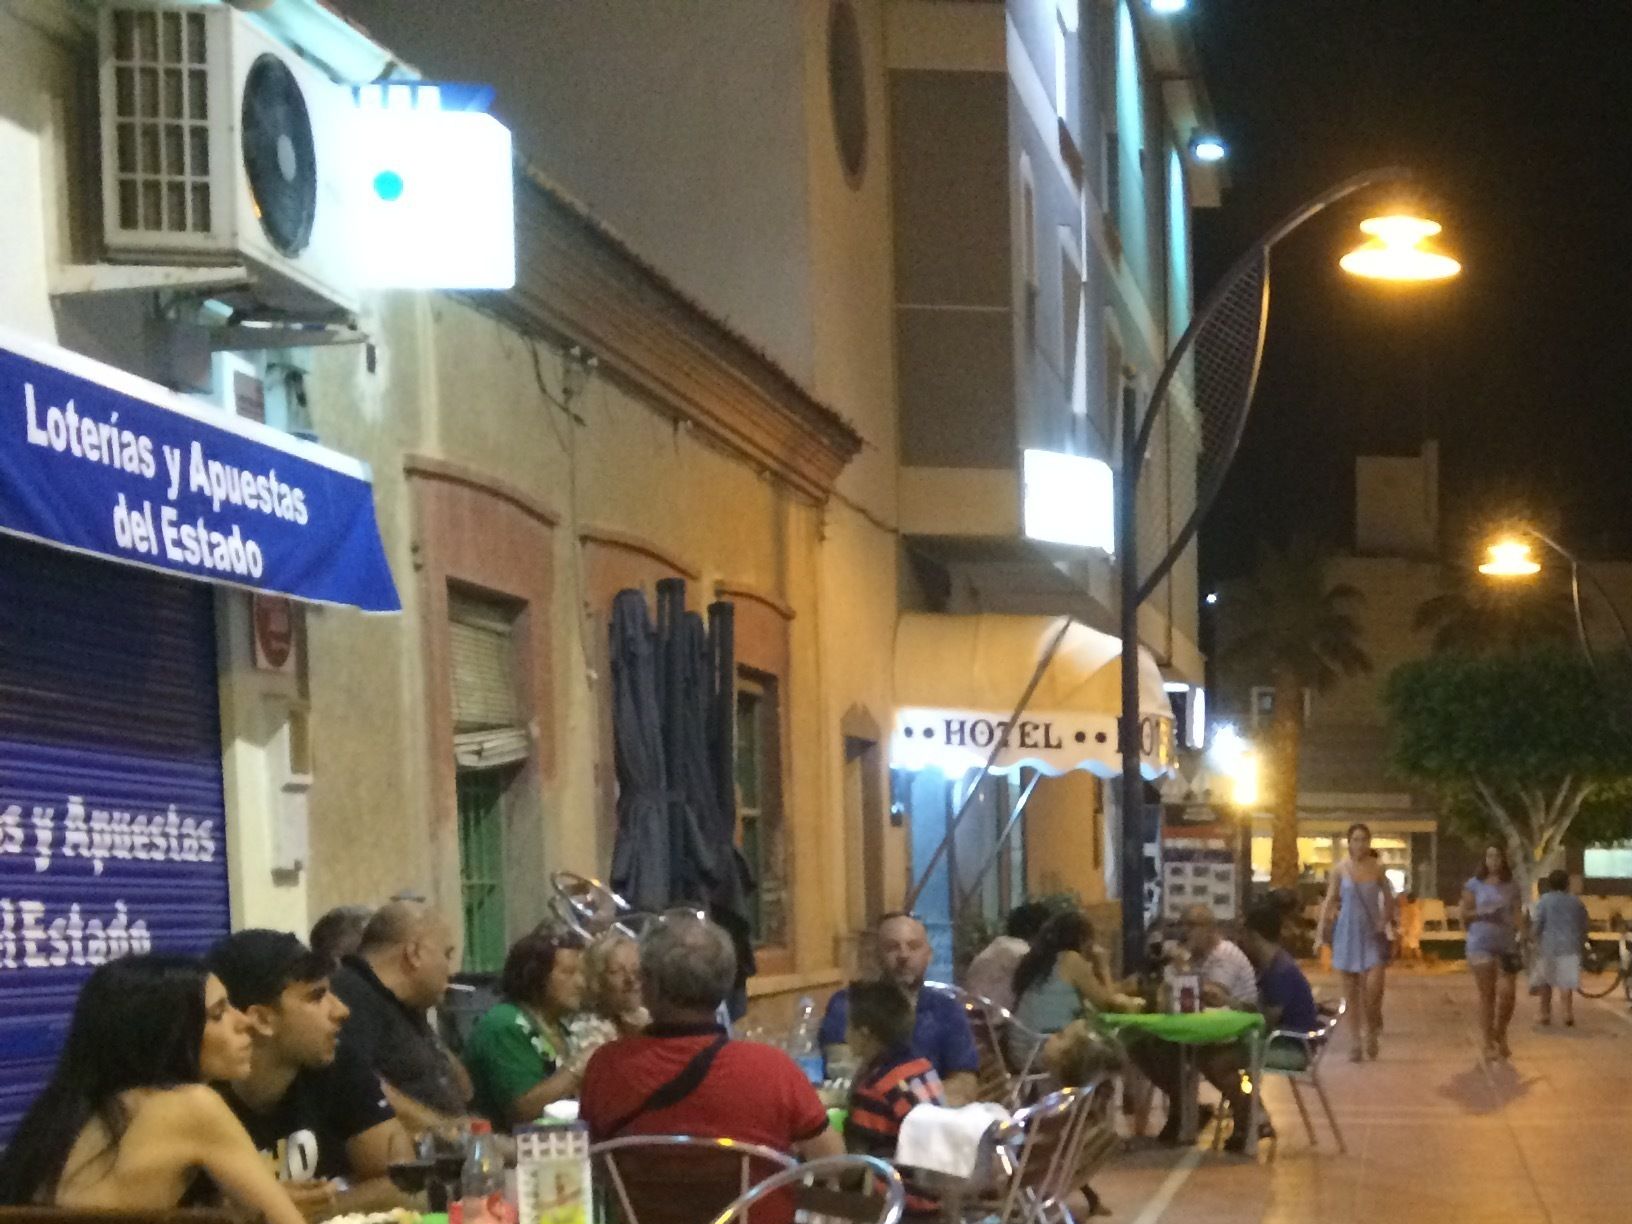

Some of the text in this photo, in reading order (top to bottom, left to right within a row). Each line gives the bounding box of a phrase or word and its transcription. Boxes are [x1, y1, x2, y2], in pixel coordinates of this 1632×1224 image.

[24, 382, 309, 526] Loterías y Apuestas
[113, 493, 264, 579] del Estado
[943, 719, 1063, 750] HOTEL
[31, 806, 54, 872] y
[62, 796, 215, 875] Apuestas
[19, 900, 151, 967] Estado
